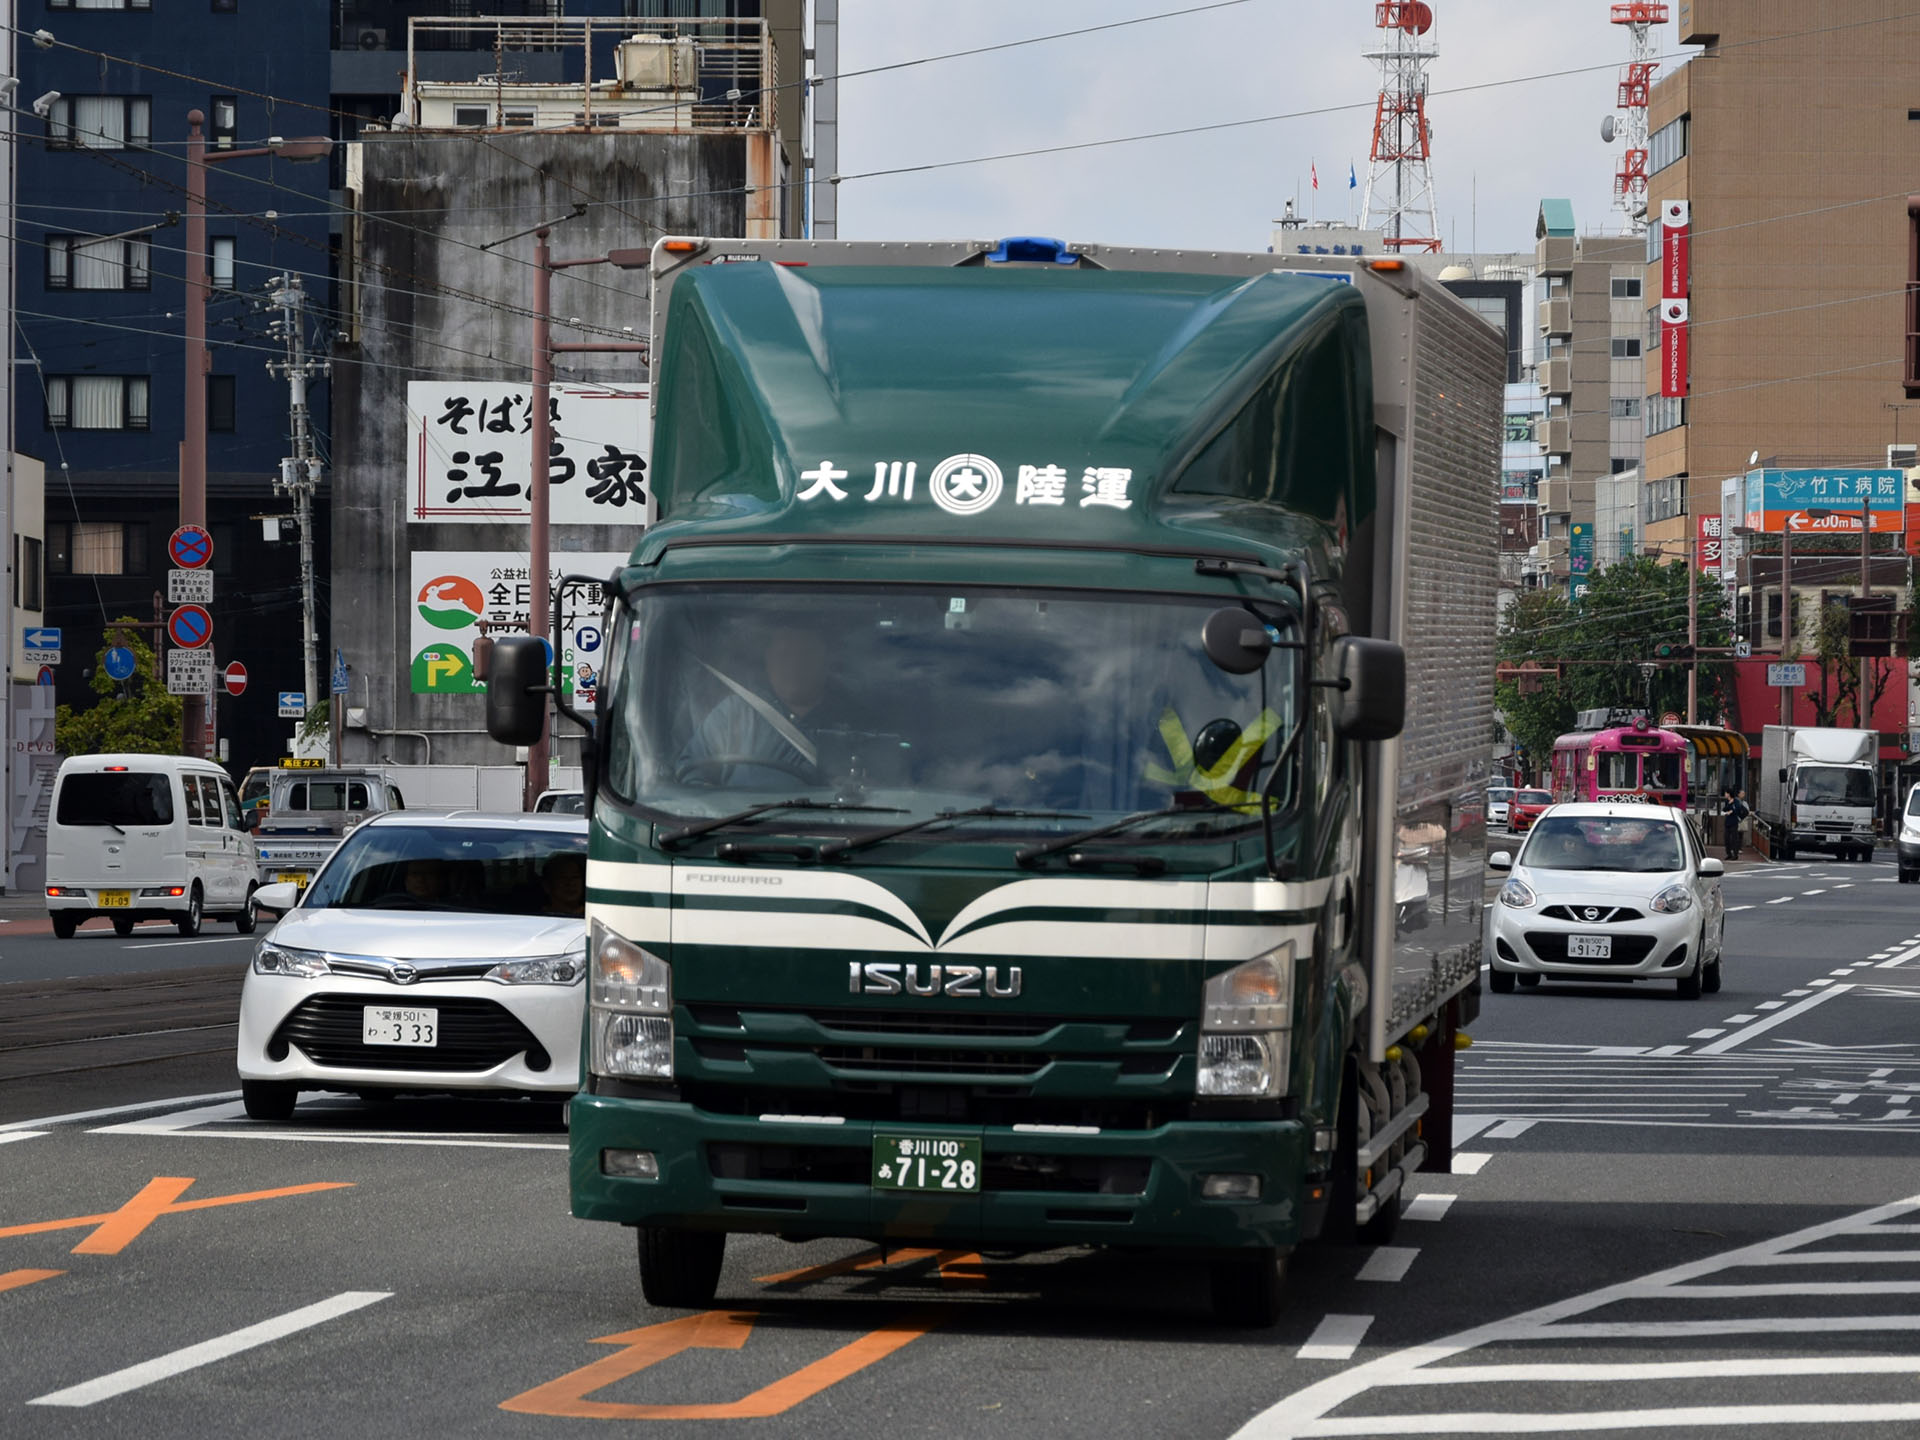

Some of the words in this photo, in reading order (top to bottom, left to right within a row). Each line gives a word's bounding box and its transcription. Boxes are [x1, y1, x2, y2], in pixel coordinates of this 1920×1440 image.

[1810, 475, 1896, 495] 竹下病院
[581, 629, 598, 649] P
[25, 652, 58, 661] ここから
[283, 759, 320, 767] 高圧ガス
[685, 872, 783, 886] FORWARD
[849, 961, 1022, 998] ISUZU
[878, 1162, 893, 1180] あ
[896, 1156, 976, 1190] 71-28
